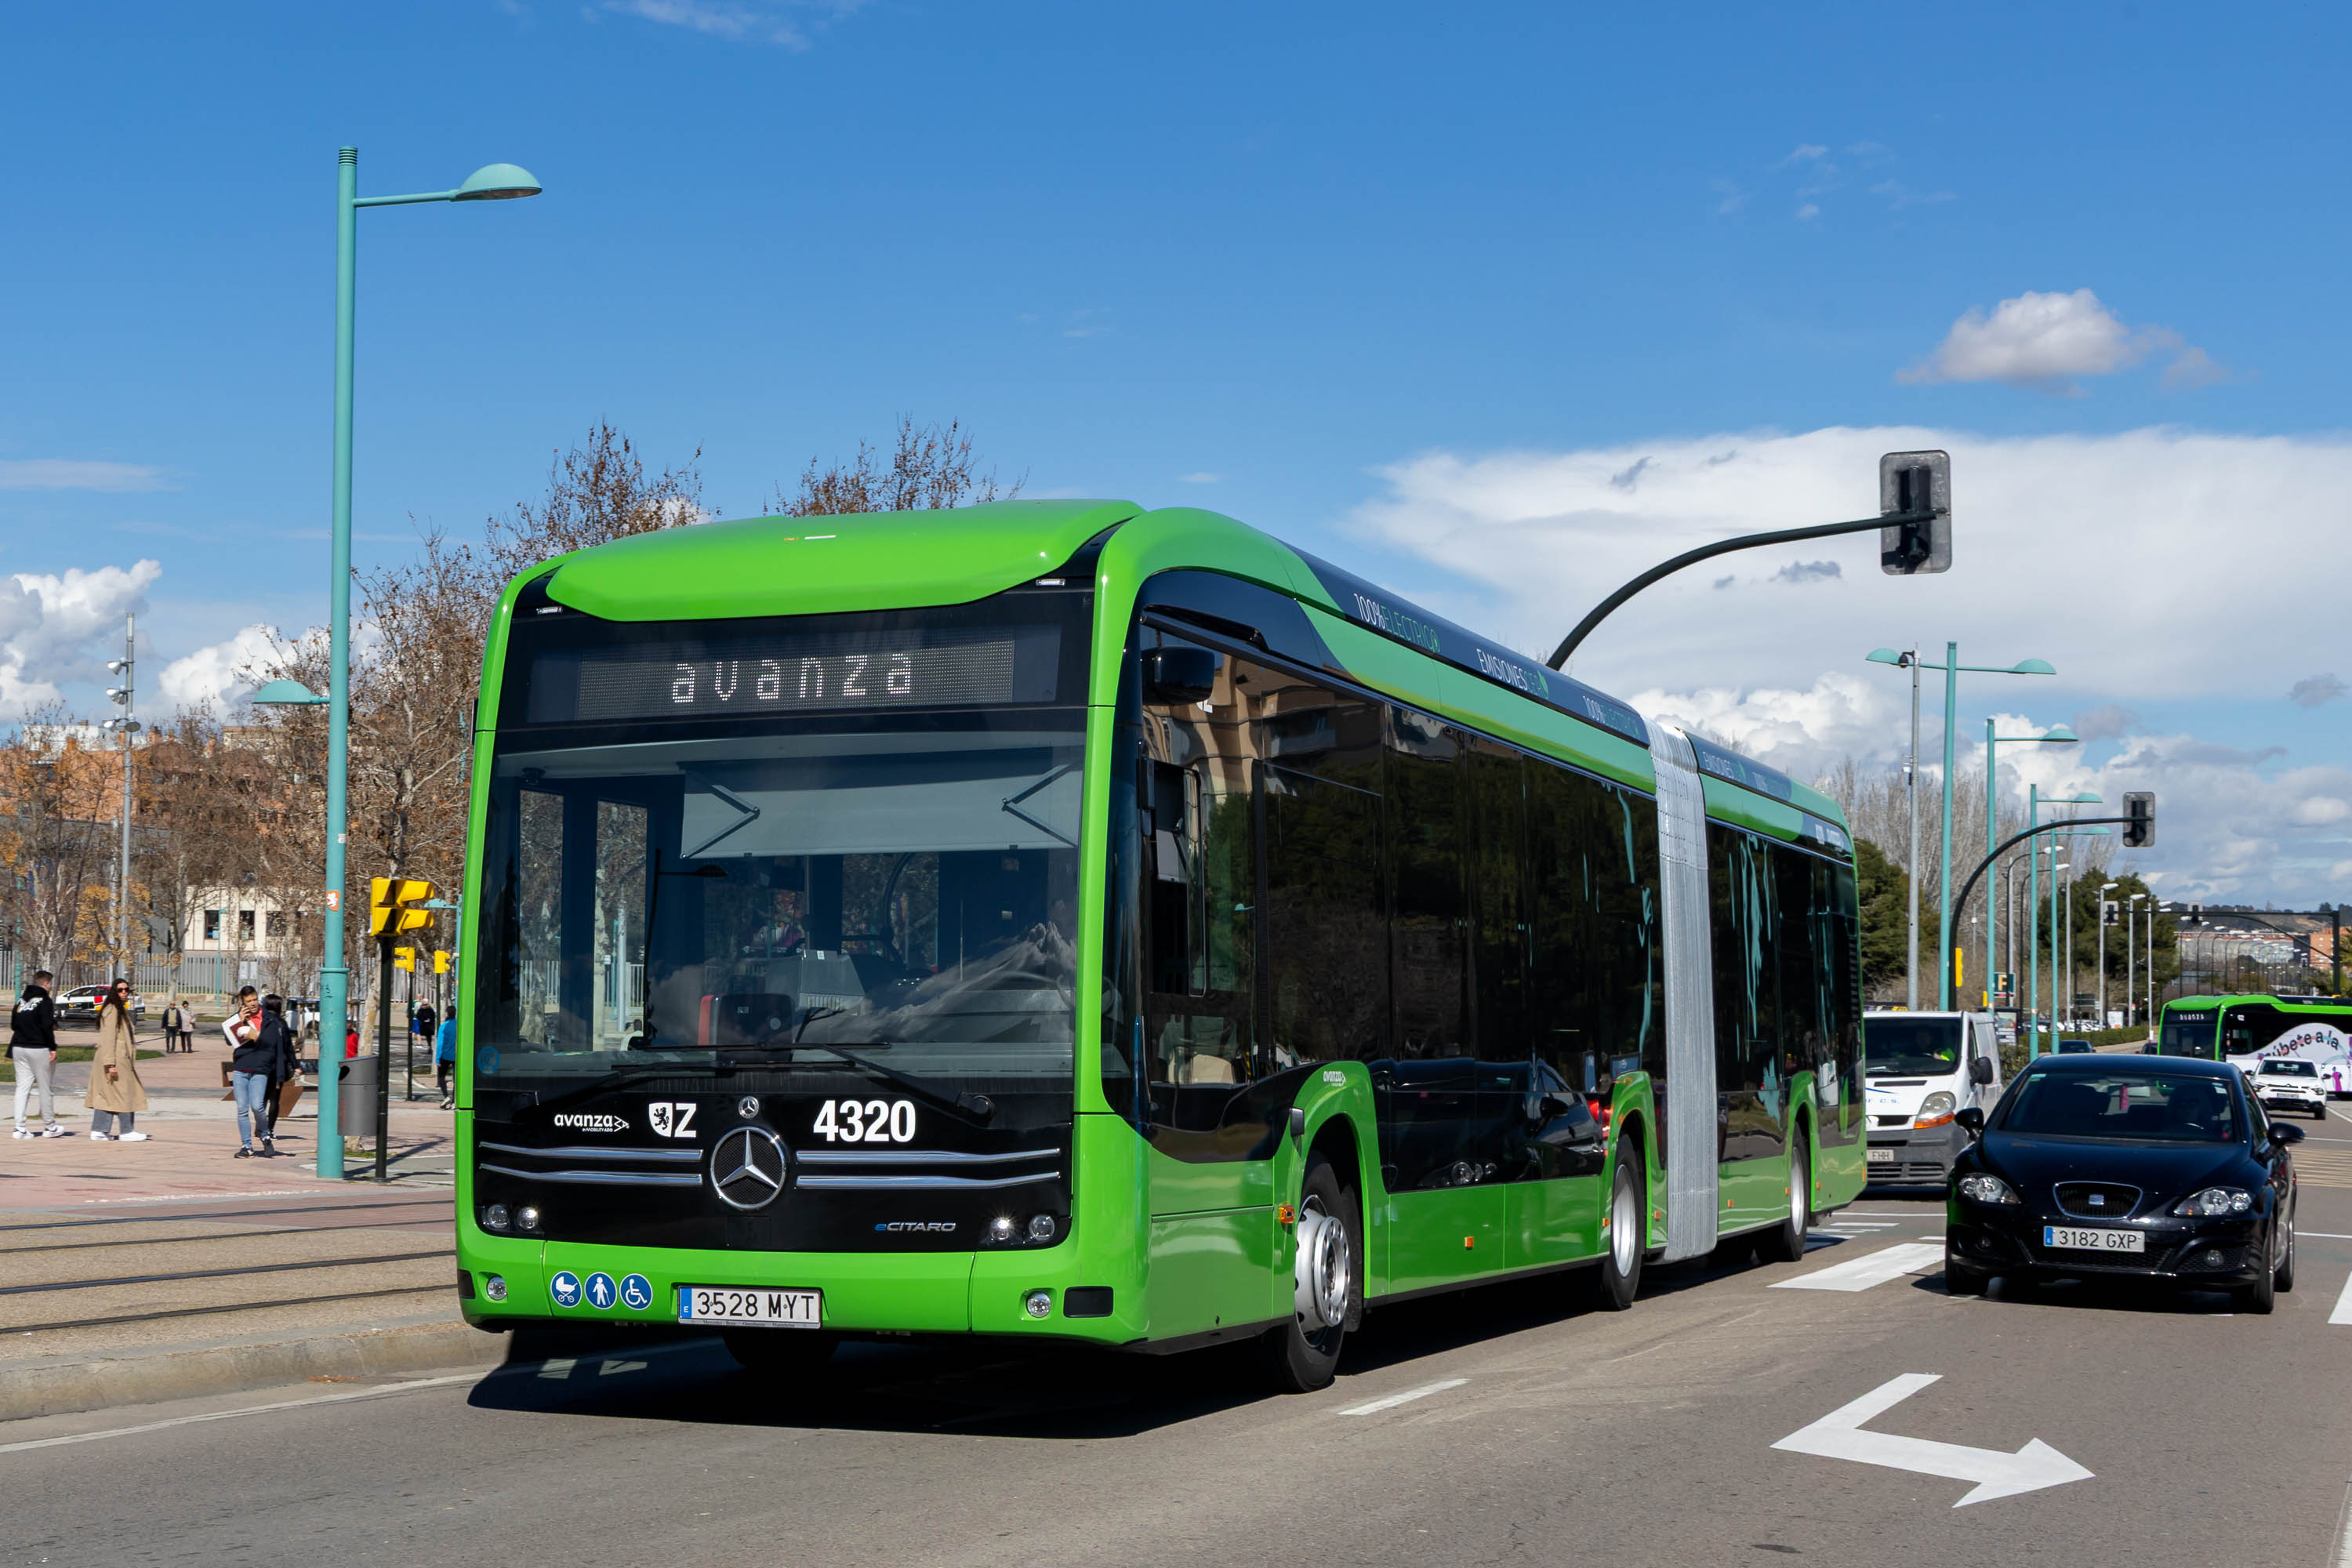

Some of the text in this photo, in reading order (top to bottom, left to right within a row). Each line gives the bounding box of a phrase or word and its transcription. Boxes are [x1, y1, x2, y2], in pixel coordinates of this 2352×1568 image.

[672, 653, 912, 703] avanza
[2316, 1032, 2324, 1044] a
[2326, 1030, 2339, 1051] la
[554, 1113, 613, 1127] avanza
[673, 1102, 697, 1138] Z
[813, 1100, 916, 1142] 4320
[874, 1222, 956, 1232] eCITARO
[2059, 1230, 2137, 1249] 3182 GXP
[697, 1291, 758, 1317] 3528
[768, 1294, 814, 1319] MYT
